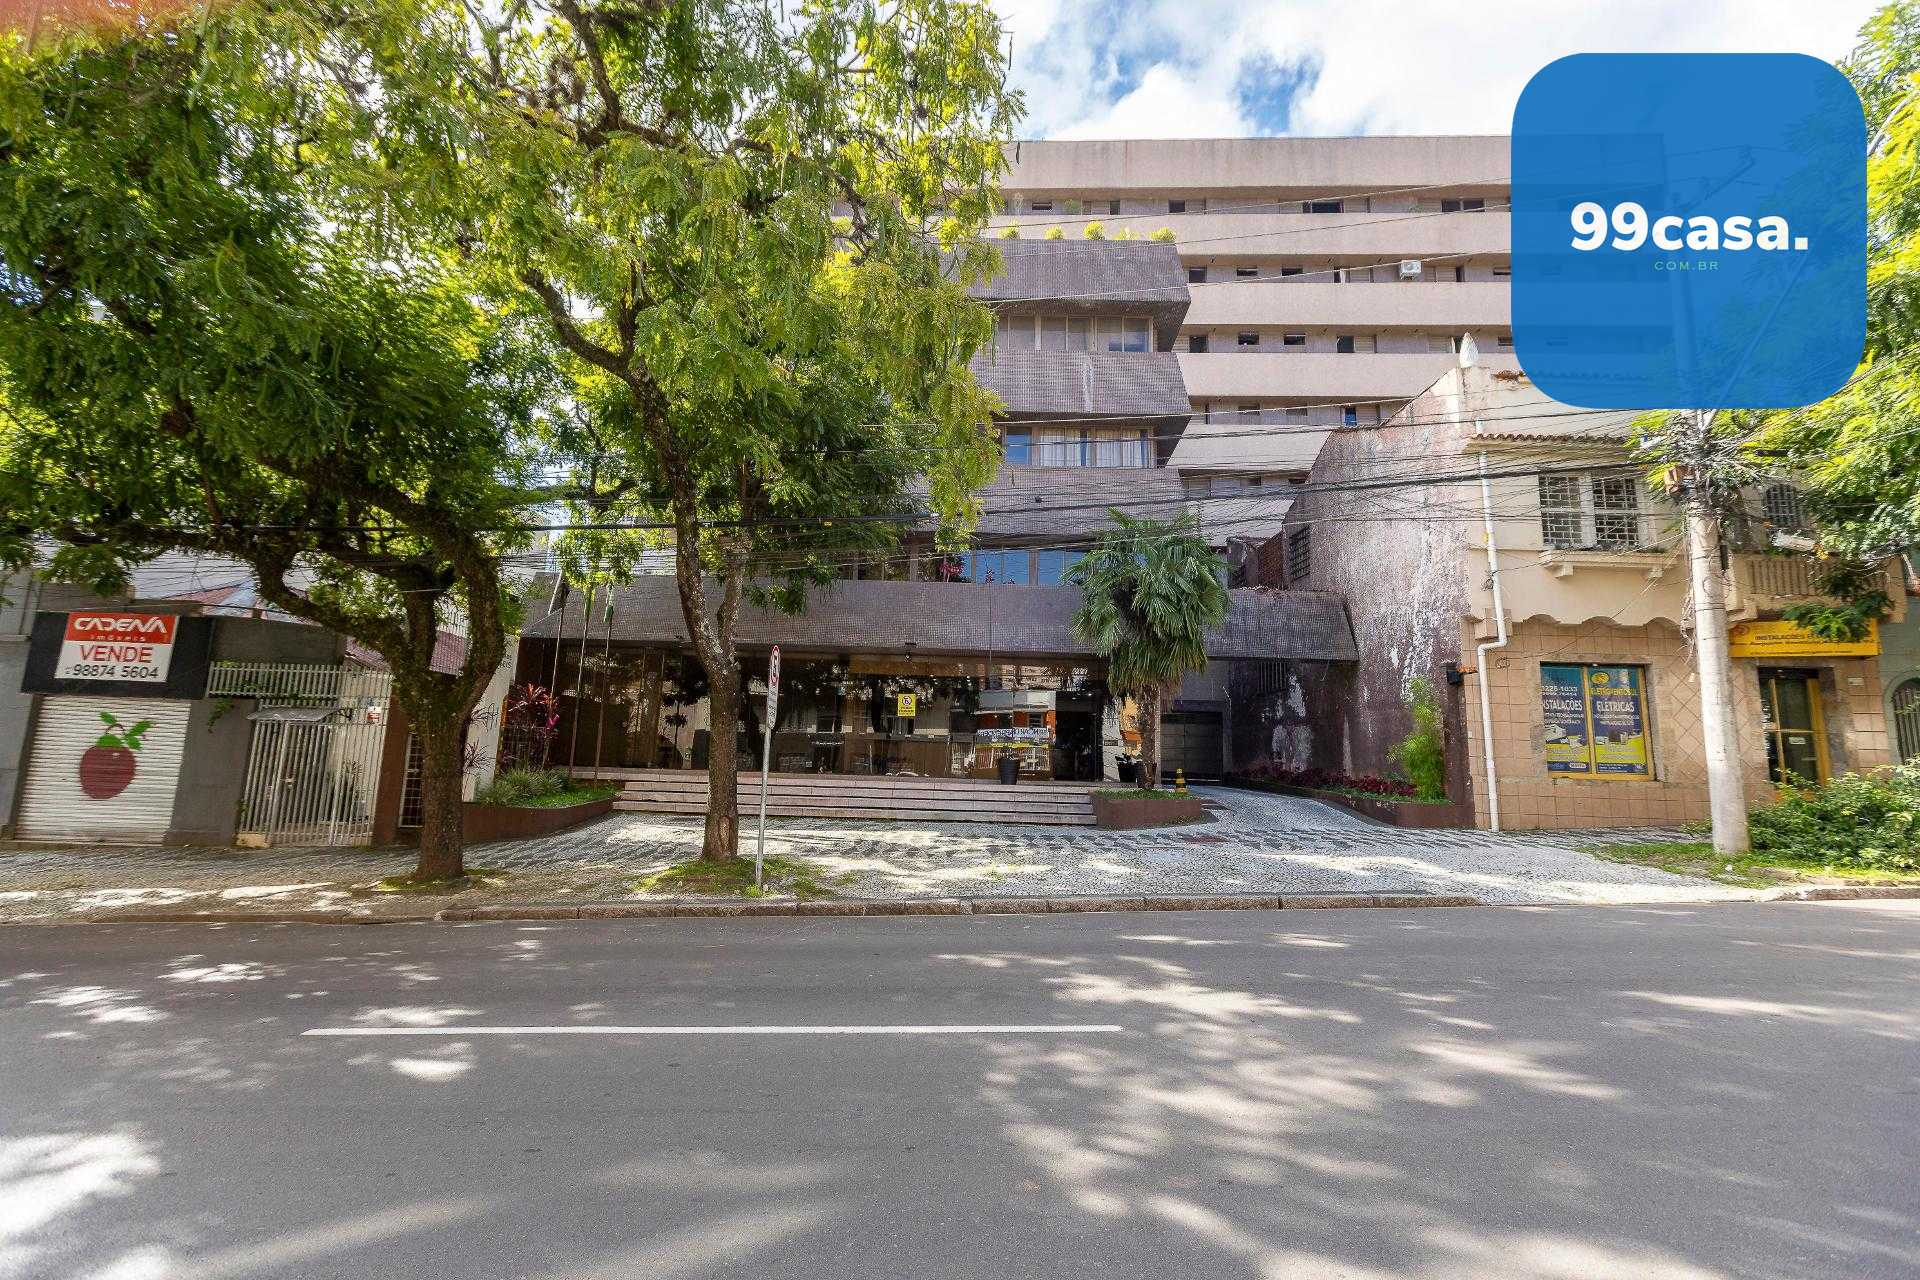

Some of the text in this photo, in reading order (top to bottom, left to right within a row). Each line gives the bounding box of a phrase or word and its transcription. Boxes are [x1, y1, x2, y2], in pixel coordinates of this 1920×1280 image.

[73, 616, 168, 634] CADENA
[79, 645, 153, 663] VENDE
[73, 664, 116, 678] 98874
[121, 665, 160, 679] 5604
